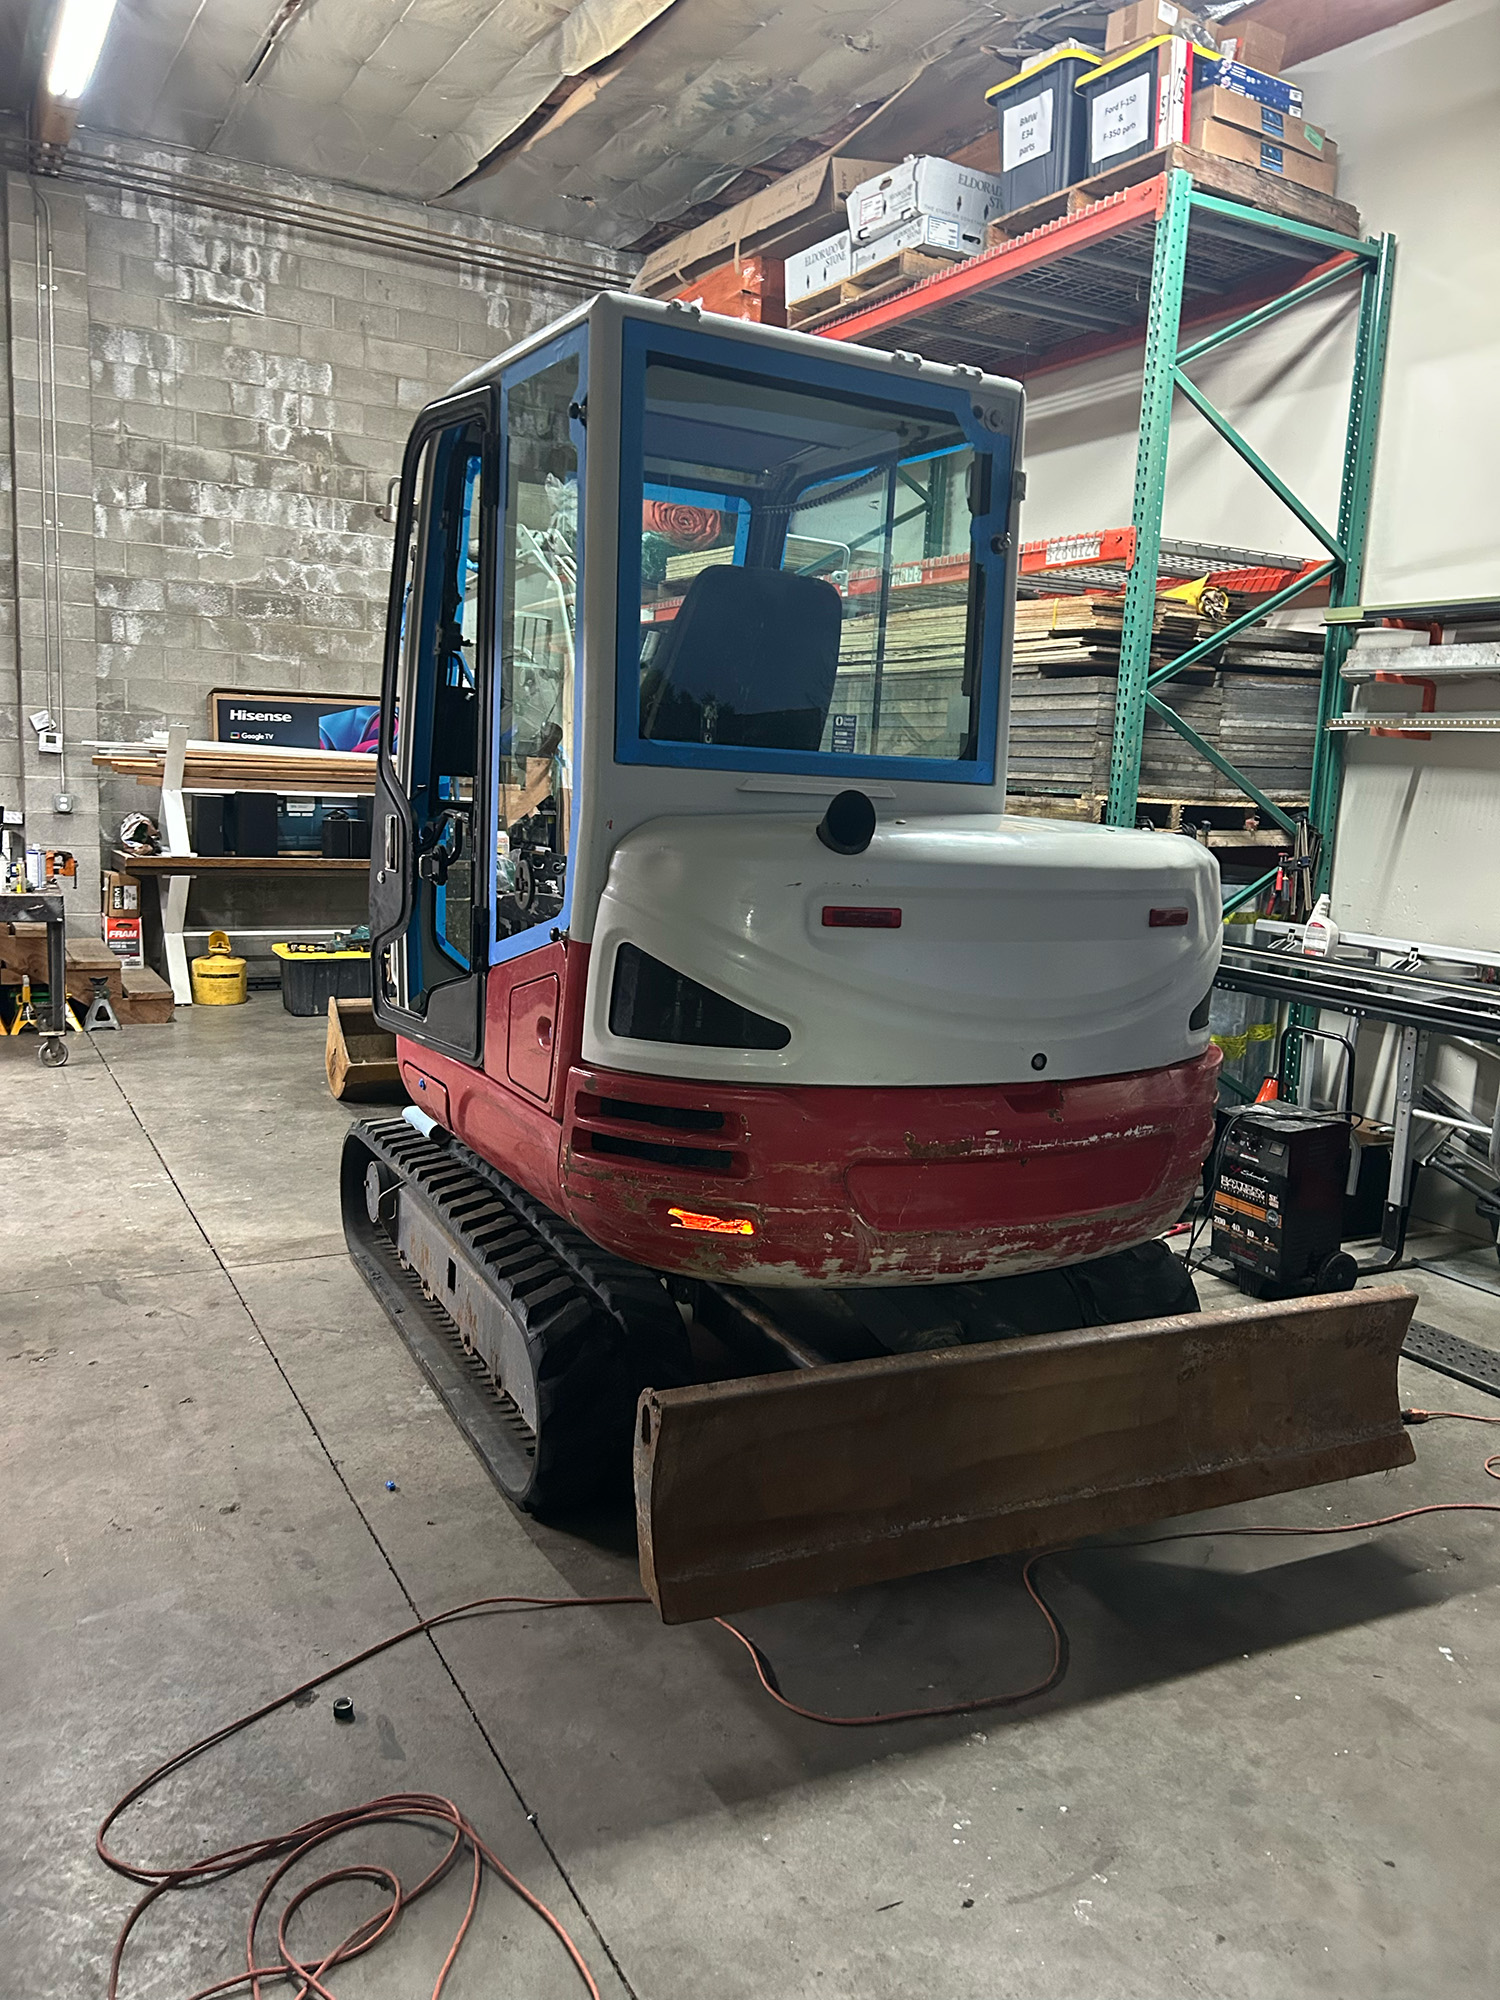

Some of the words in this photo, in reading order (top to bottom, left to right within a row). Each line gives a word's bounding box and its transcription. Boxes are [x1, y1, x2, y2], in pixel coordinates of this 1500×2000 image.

[1105, 102, 1119, 115] Ford
[1019, 112, 1038, 127] BMW
[1118, 114, 1124, 122] &
[1021, 128, 1034, 140] E34
[1103, 128, 1121, 141] F-350
[1122, 122, 1136, 135] parts
[1018, 143, 1036, 157] parts
[958, 173, 1003, 196] ELDORAD
[229, 709, 292, 722] Hisense
[241, 732, 264, 741] Google
[109, 930, 138, 938] FRAM
[1213, 1215, 1226, 1226] 200
[1231, 1223, 1240, 1232] 40
[1247, 1228, 1255, 1238] 10
[1264, 1236, 1270, 1244] 2
